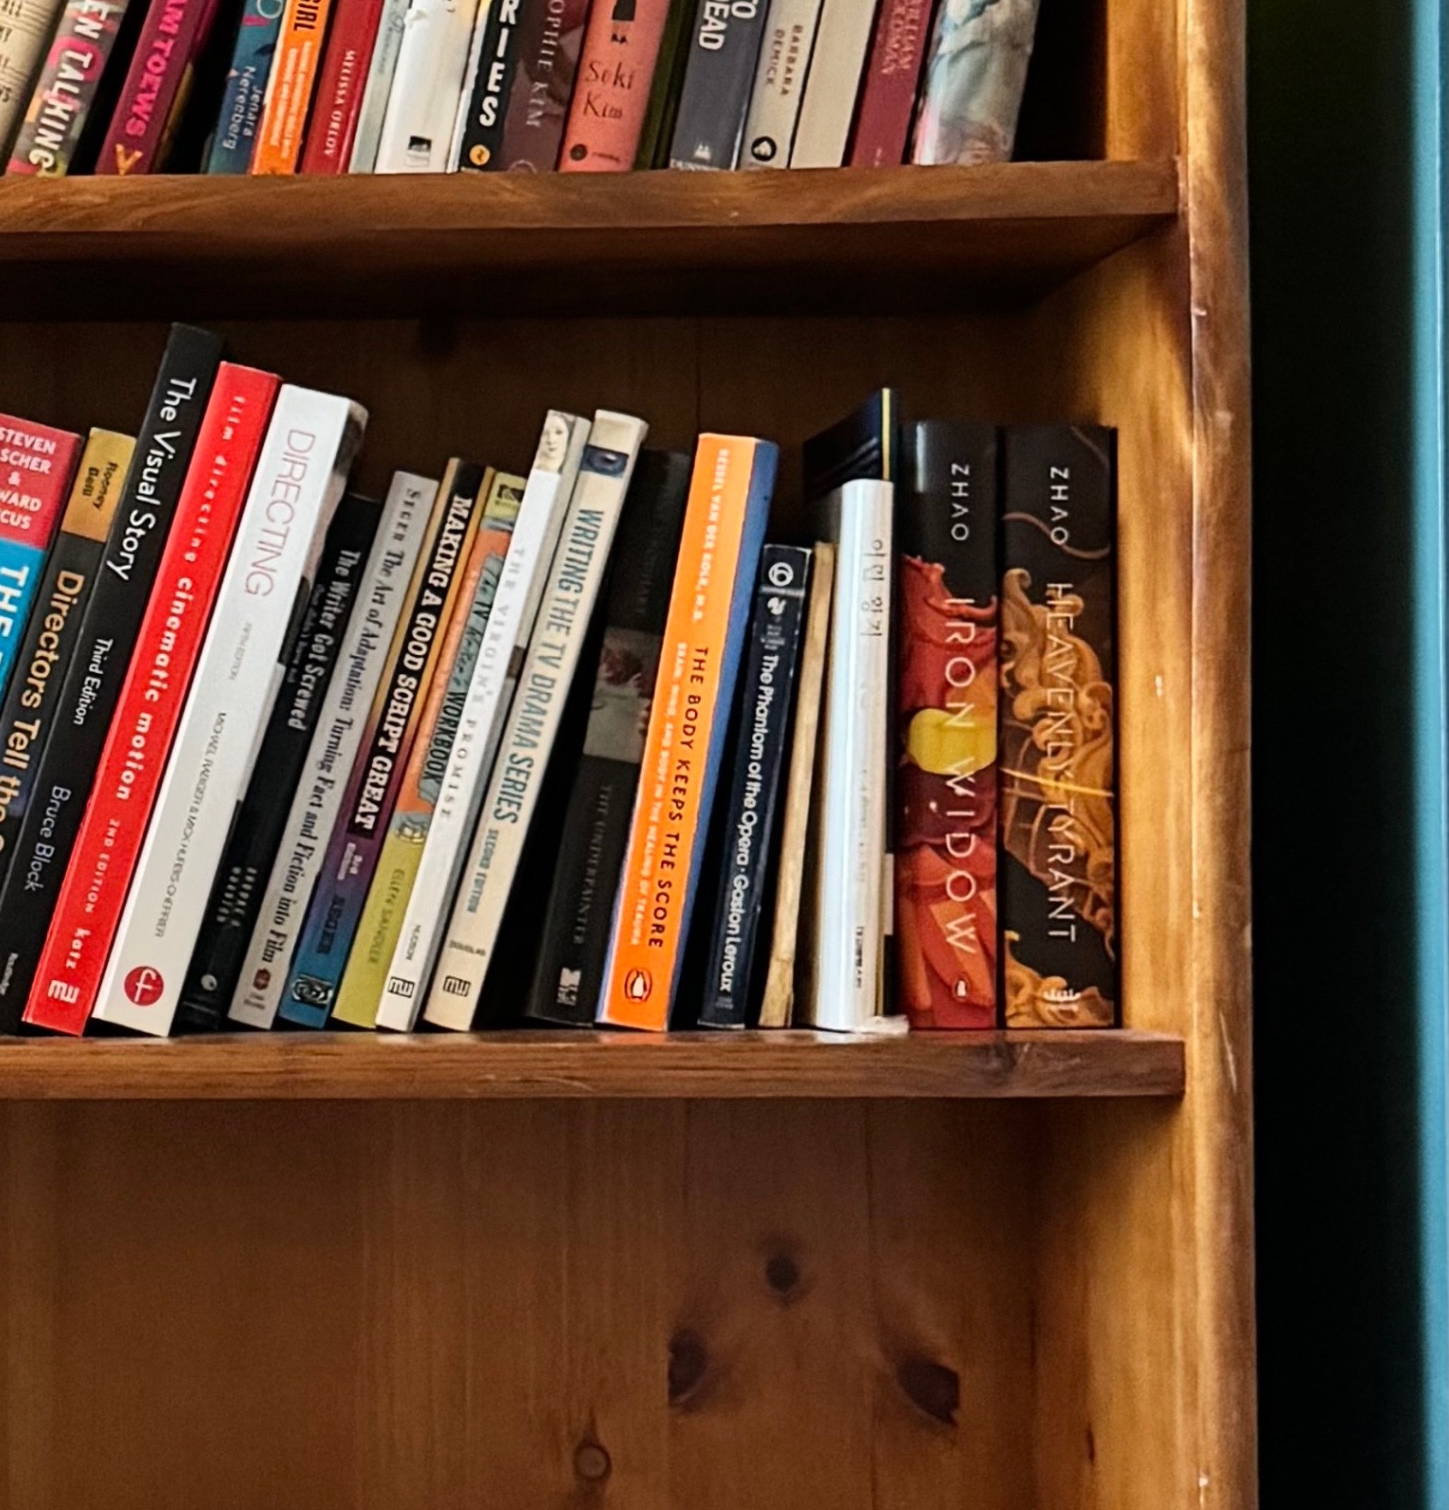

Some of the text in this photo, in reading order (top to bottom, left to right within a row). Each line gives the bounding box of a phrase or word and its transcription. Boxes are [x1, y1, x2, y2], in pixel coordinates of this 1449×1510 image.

[123, 37, 173, 138] TOEWS
[103, 371, 196, 582] The Visual Story
[182, 394, 246, 564] film directing
[949, 463, 969, 540] ZHAO
[1049, 466, 1068, 545] ZHAO
[241, 427, 317, 600] DIRECTING
[425, 494, 471, 588] MAKING
[335, 547, 360, 578] The
[371, 581, 393, 606] Art
[380, 547, 404, 579] The
[318, 578, 351, 630] Writer
[365, 607, 385, 627] of
[419, 589, 443, 609] A
[19, 568, 84, 710] Directors
[308, 631, 334, 662] Got
[400, 611, 436, 673] GOOD
[492, 505, 605, 824] WRITING THE TV DRAMA SERIES
[759, 653, 781, 685] The
[69, 634, 112, 728] Third Edition
[113, 574, 198, 802] cinematic motion
[286, 663, 325, 731] Screwed
[334, 627, 380, 714] Adaptation:
[1, 713, 40, 770] Tell
[374, 672, 418, 753] SCRIPT
[748, 685, 776, 760] Phantom
[316, 713, 354, 775] Turning
[745, 761, 765, 781] of
[1047, 583, 1075, 941] HEAVENLY TYRANT
[308, 774, 335, 810] Fact
[351, 752, 395, 831] GREAT
[647, 645, 709, 949] THE BODY KEEPS THE SCORE
[742, 780, 762, 808] the
[943, 598, 976, 954] IRON WIDOW
[20, 783, 71, 893] Bruce Block
[298, 810, 323, 840] and
[731, 809, 759, 866] Opera
[82, 818, 119, 914] 2ND EDITION
[282, 841, 314, 895] Fiction
[272, 895, 297, 927] into
[724, 873, 750, 935] Gaston
[63, 926, 90, 971] katz
[260, 928, 288, 965] Film
[717, 936, 741, 993] Leroux
